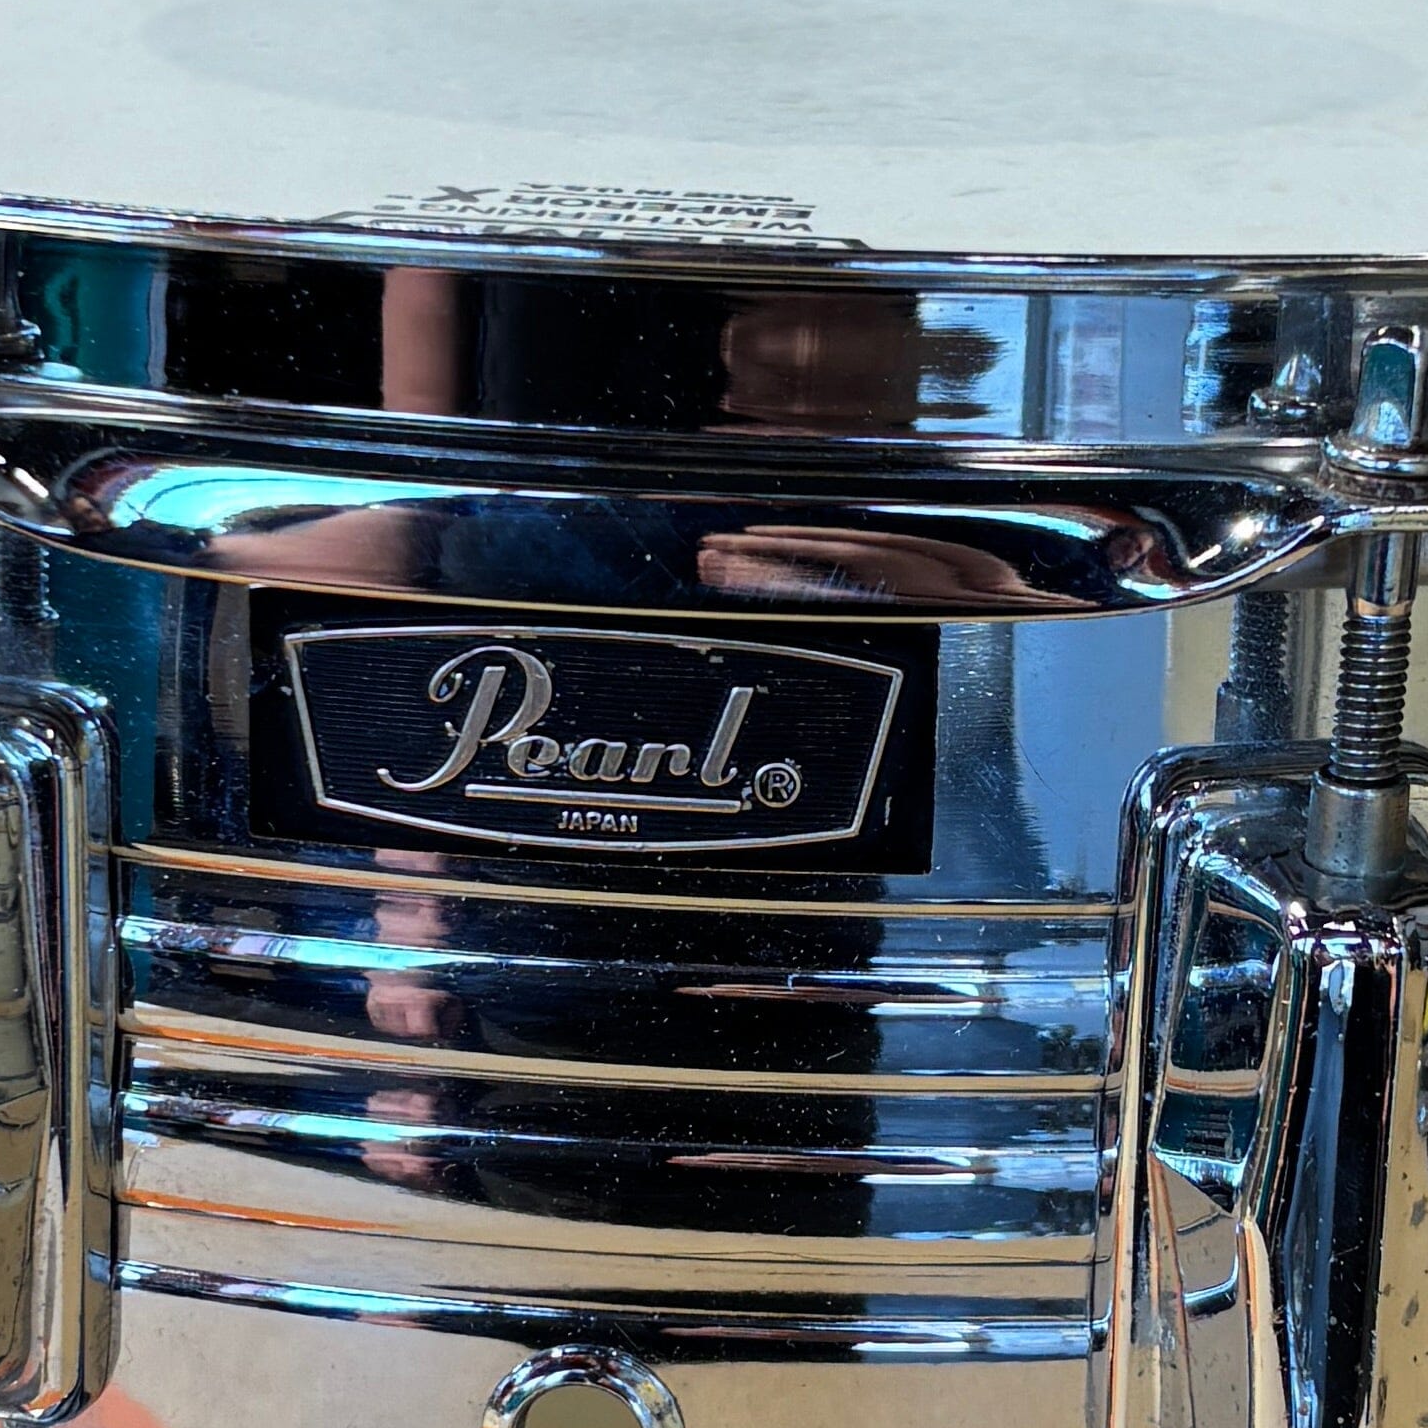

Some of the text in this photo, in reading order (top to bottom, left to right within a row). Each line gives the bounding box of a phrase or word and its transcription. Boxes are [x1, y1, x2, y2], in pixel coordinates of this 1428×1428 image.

[420, 185, 815, 220] EMPEROR X
[417, 203, 814, 233] WEATHERKING
[556, 809, 639, 834] JAPAN
